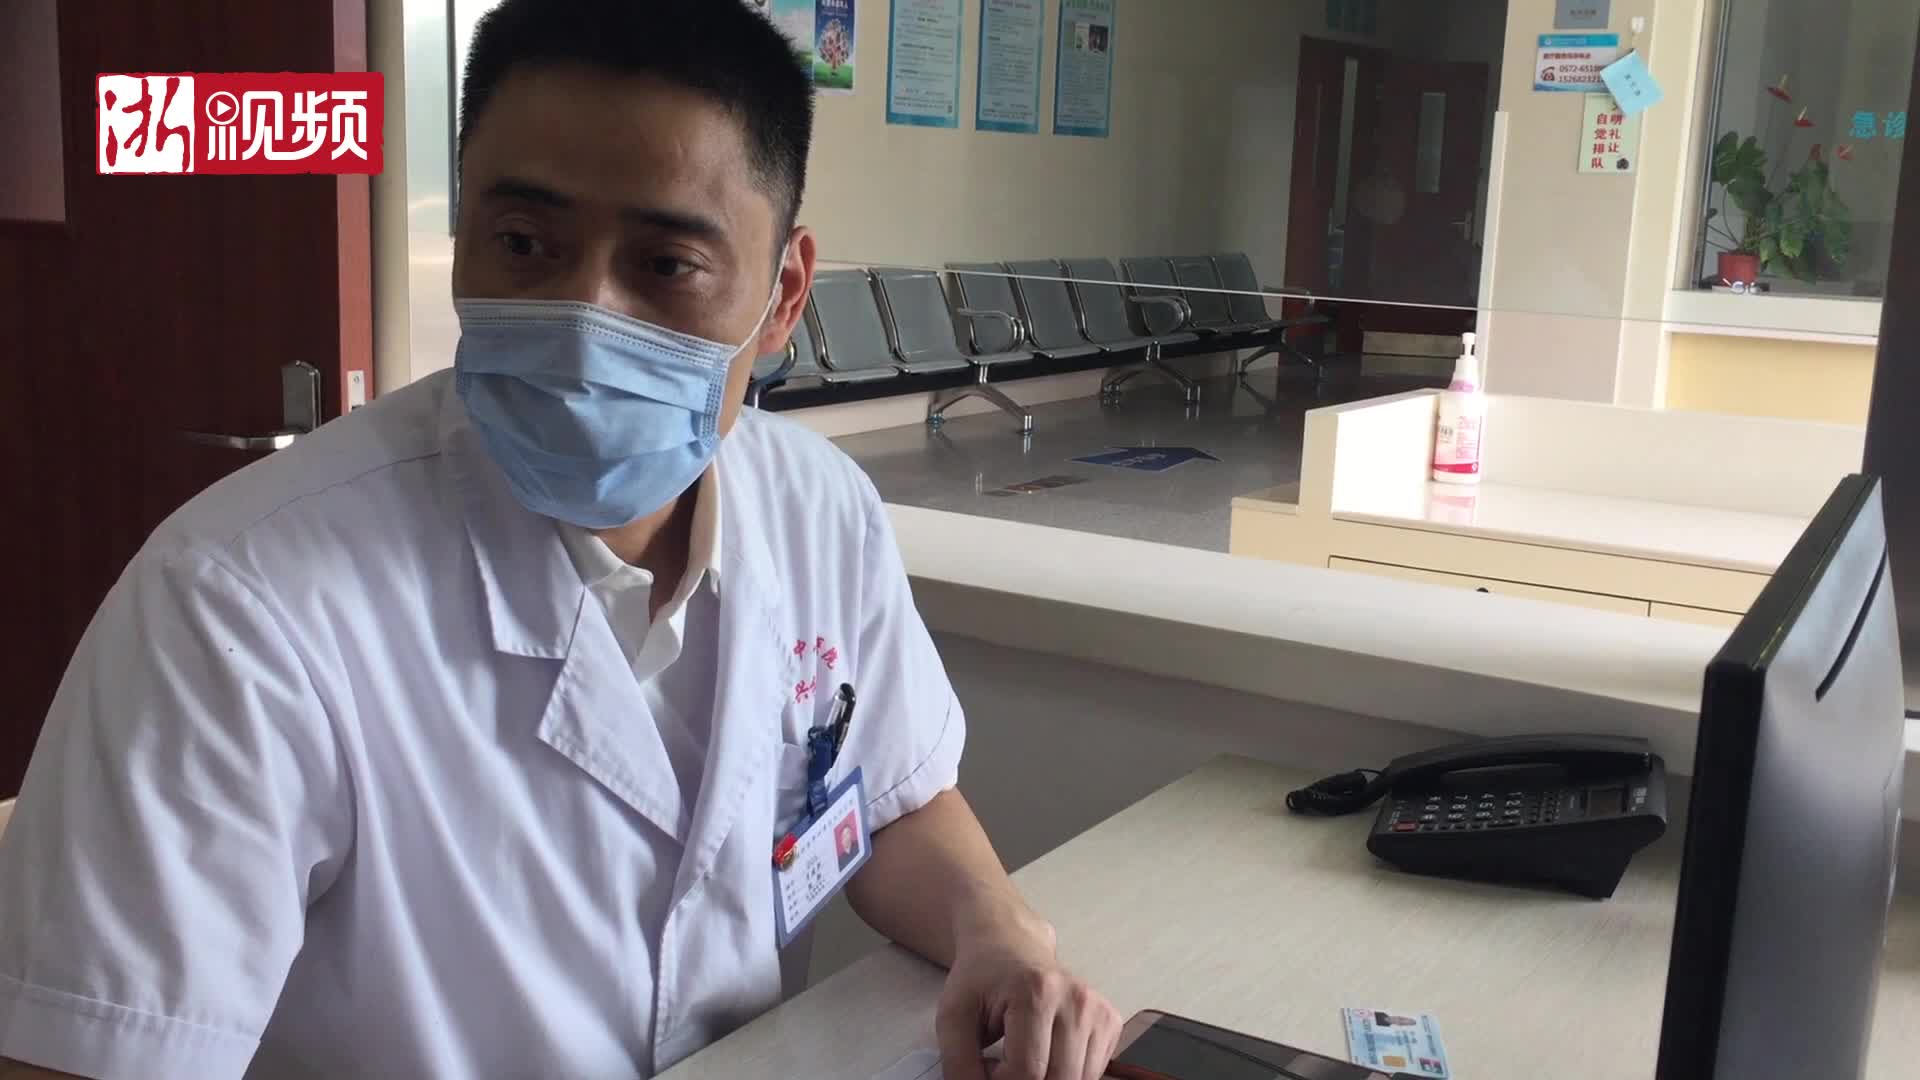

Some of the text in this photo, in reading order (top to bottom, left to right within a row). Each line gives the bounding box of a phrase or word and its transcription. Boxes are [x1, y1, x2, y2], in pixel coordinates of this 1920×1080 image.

[1591, 113, 1608, 169] 自觉排队
[1848, 111, 1905, 139] 急诊
